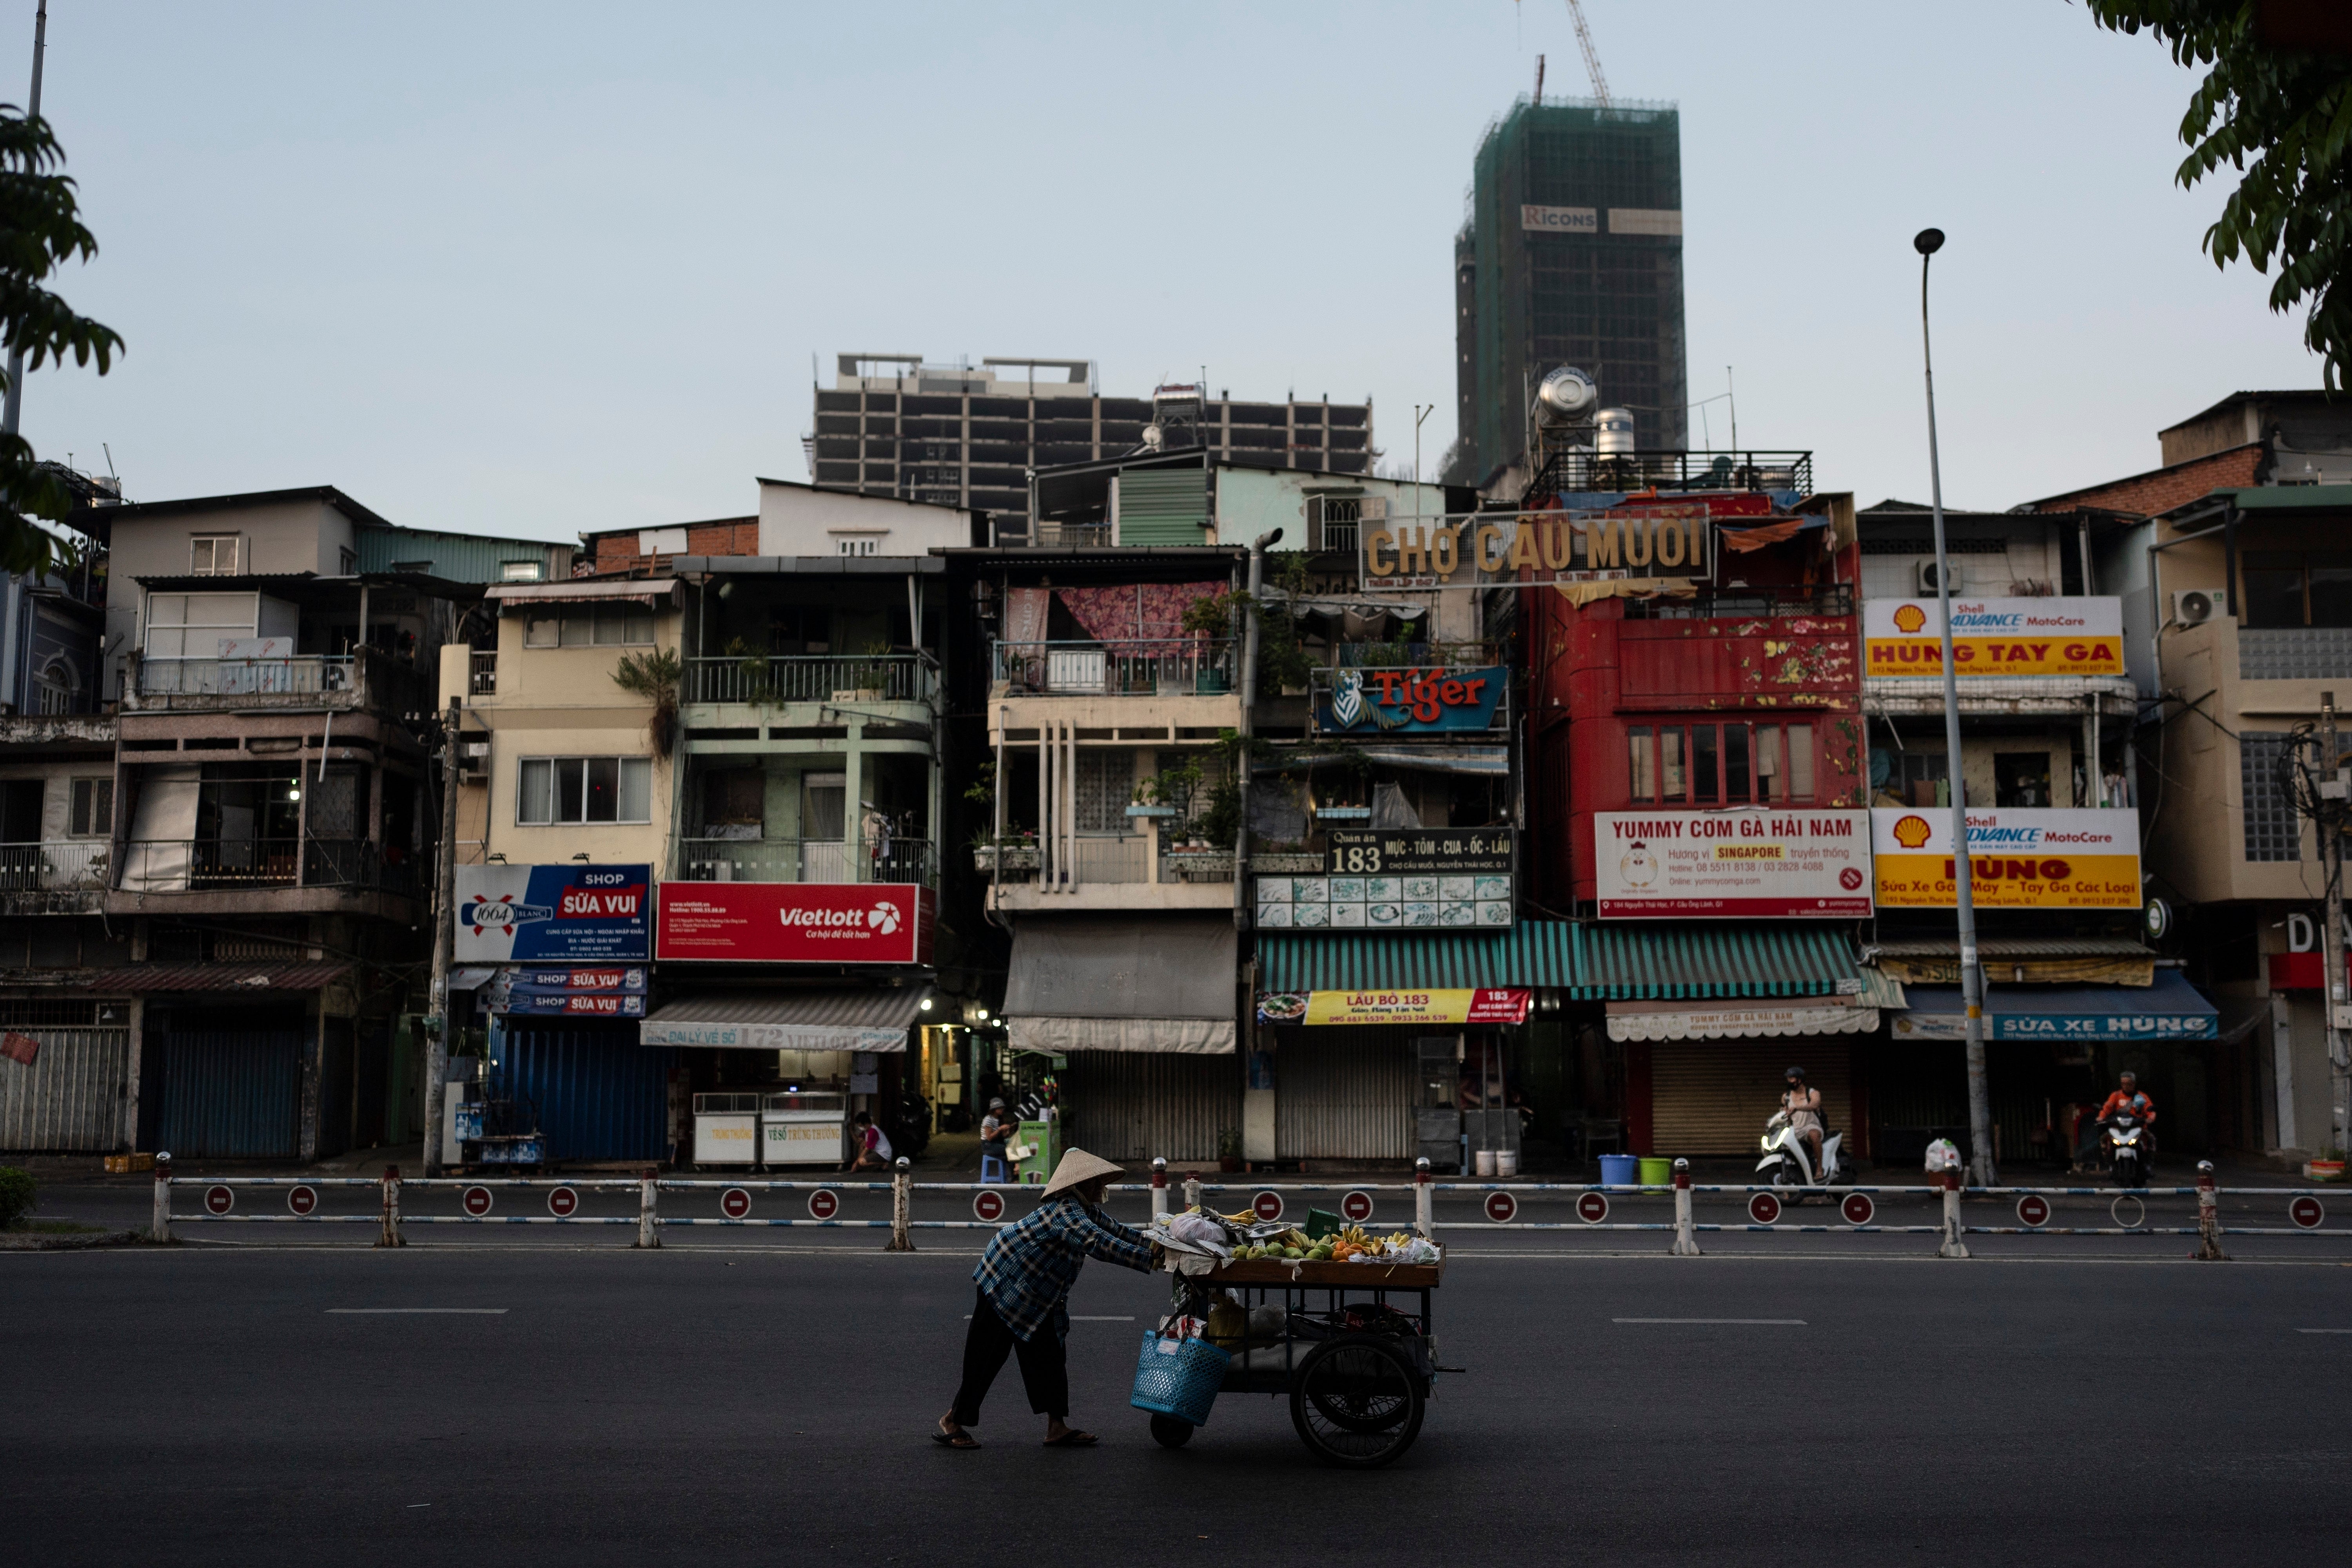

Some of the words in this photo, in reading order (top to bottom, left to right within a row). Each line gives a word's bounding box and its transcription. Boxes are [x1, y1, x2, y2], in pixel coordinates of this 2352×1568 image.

[1368, 524, 1461, 583] CHỢ
[1586, 508, 1701, 569] MUỐI
[1958, 604, 1984, 614] Shell
[1950, 613, 2023, 626] ADVANCE
[2027, 617, 2084, 626] MotoCare
[1873, 641, 1975, 662] HÙNG
[1988, 644, 2051, 661] TAY
[2064, 644, 2114, 661] GA
[1613, 821, 1683, 838] YUMMY
[1690, 818, 1733, 837] CƠM
[1741, 817, 1765, 837] GÀ
[1772, 815, 1802, 836] HẢI
[1811, 819, 1852, 836] NAM
[1965, 817, 1996, 827] Shell
[1334, 831, 1361, 844] Quán
[1951, 828, 2042, 842] DVANCE
[2045, 832, 2112, 843] MotoCare
[1443, 840, 1462, 855] CUA
[1668, 849, 1699, 860] Hương
[1718, 847, 1781, 858] SINGAPORE
[1333, 847, 1381, 873] 183
[1710, 863, 1731, 872] 5511
[585, 874, 624, 885] SHOP
[1912, 882, 1930, 892] Xe
[2020, 881, 2043, 895] Tay
[2049, 882, 2070, 893] Ga
[564, 892, 601, 914] SỮA
[605, 895, 636, 914] VUI
[477, 904, 509, 921] 1664
[780, 907, 864, 927] Vietlott
[537, 975, 567, 984] SHOP
[599, 975, 618, 986] VUI
[1404, 995, 1429, 1005] 183
[1488, 991, 1509, 1001] 183
[536, 997, 565, 1006] SHOP
[597, 998, 617, 1011] VUI
[2063, 1019, 2096, 1032] XE
[741, 1027, 783, 1049] 172
